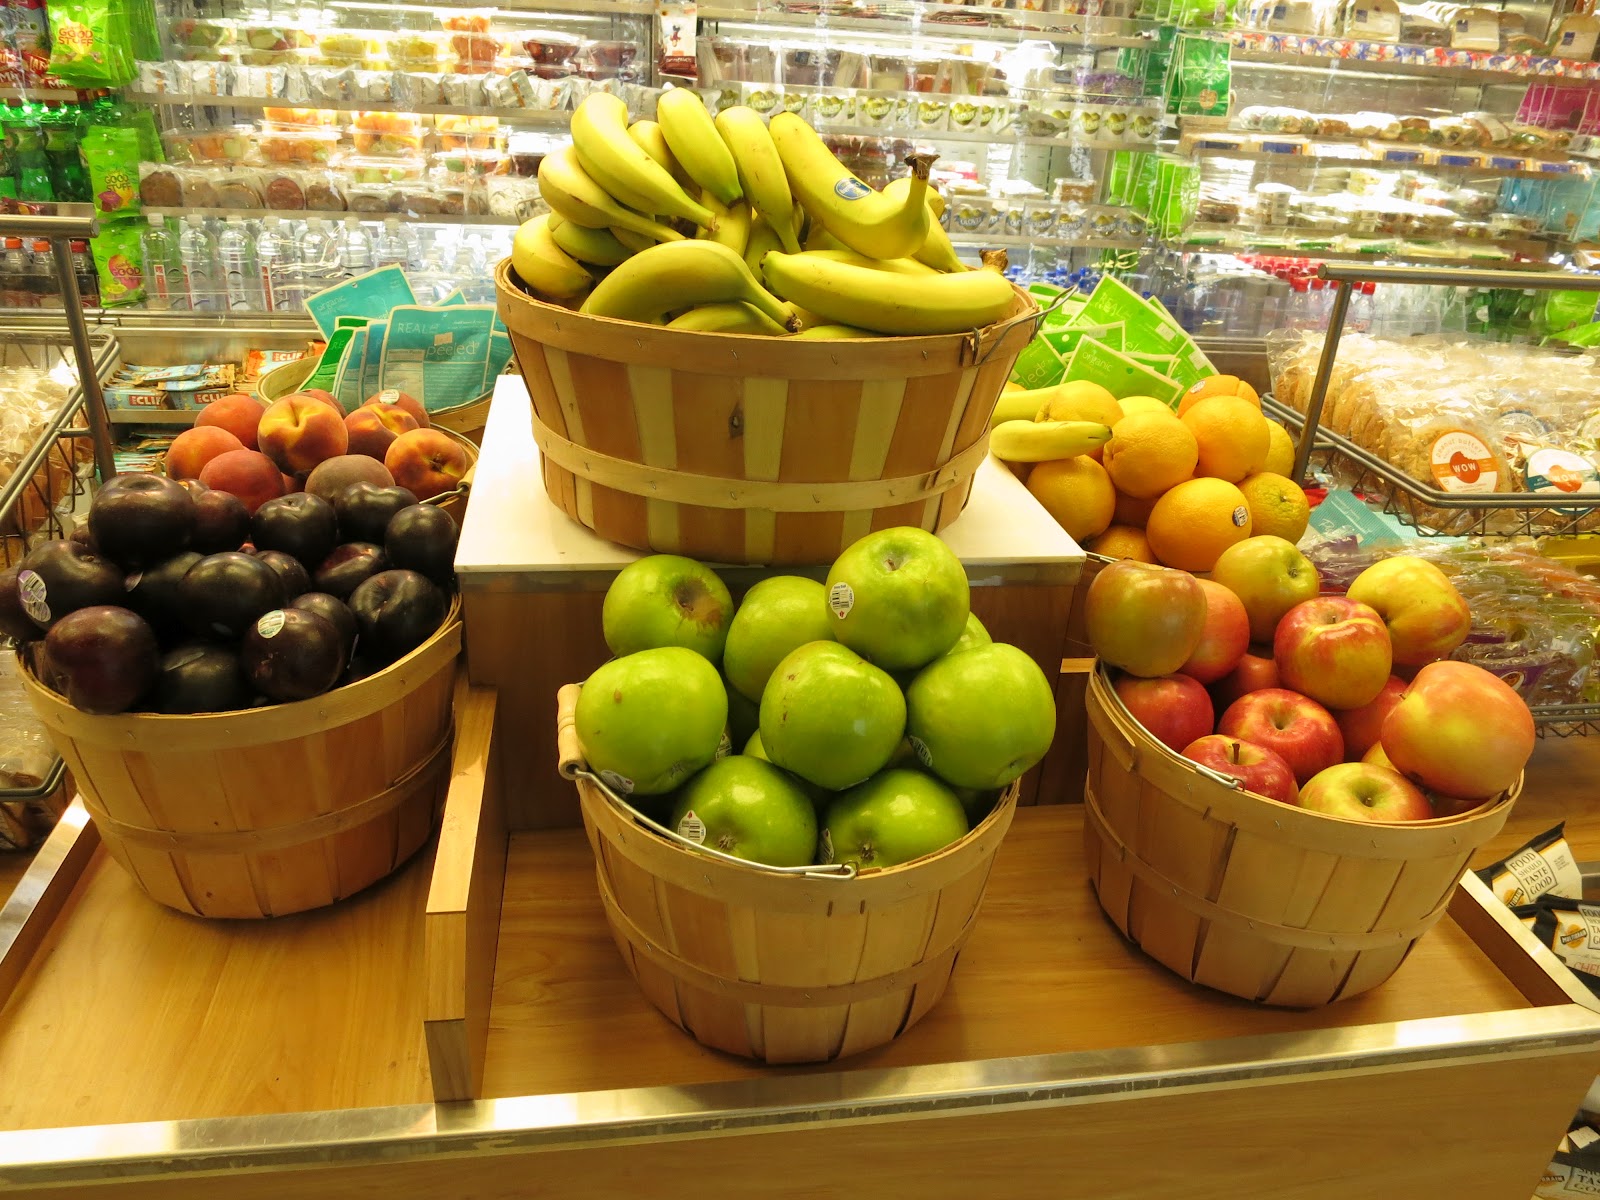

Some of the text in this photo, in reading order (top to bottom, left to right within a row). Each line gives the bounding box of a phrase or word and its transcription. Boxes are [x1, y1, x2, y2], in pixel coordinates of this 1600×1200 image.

[58, 27, 94, 38] GOOD
[58, 36, 94, 47] STUFF
[105, 174, 129, 184] GOOD
[426, 340, 476, 358] peeled
[279, 352, 303, 361] CLIF
[1082, 352, 1113, 371] organic
[1452, 462, 1477, 473] WOW
[1551, 473, 1577, 482] WOW
[1510, 852, 1537, 871] FOOD
[1518, 860, 1543, 877] SHOULD
[1524, 867, 1549, 886] TASTE
[1529, 875, 1553, 896] GOOD
